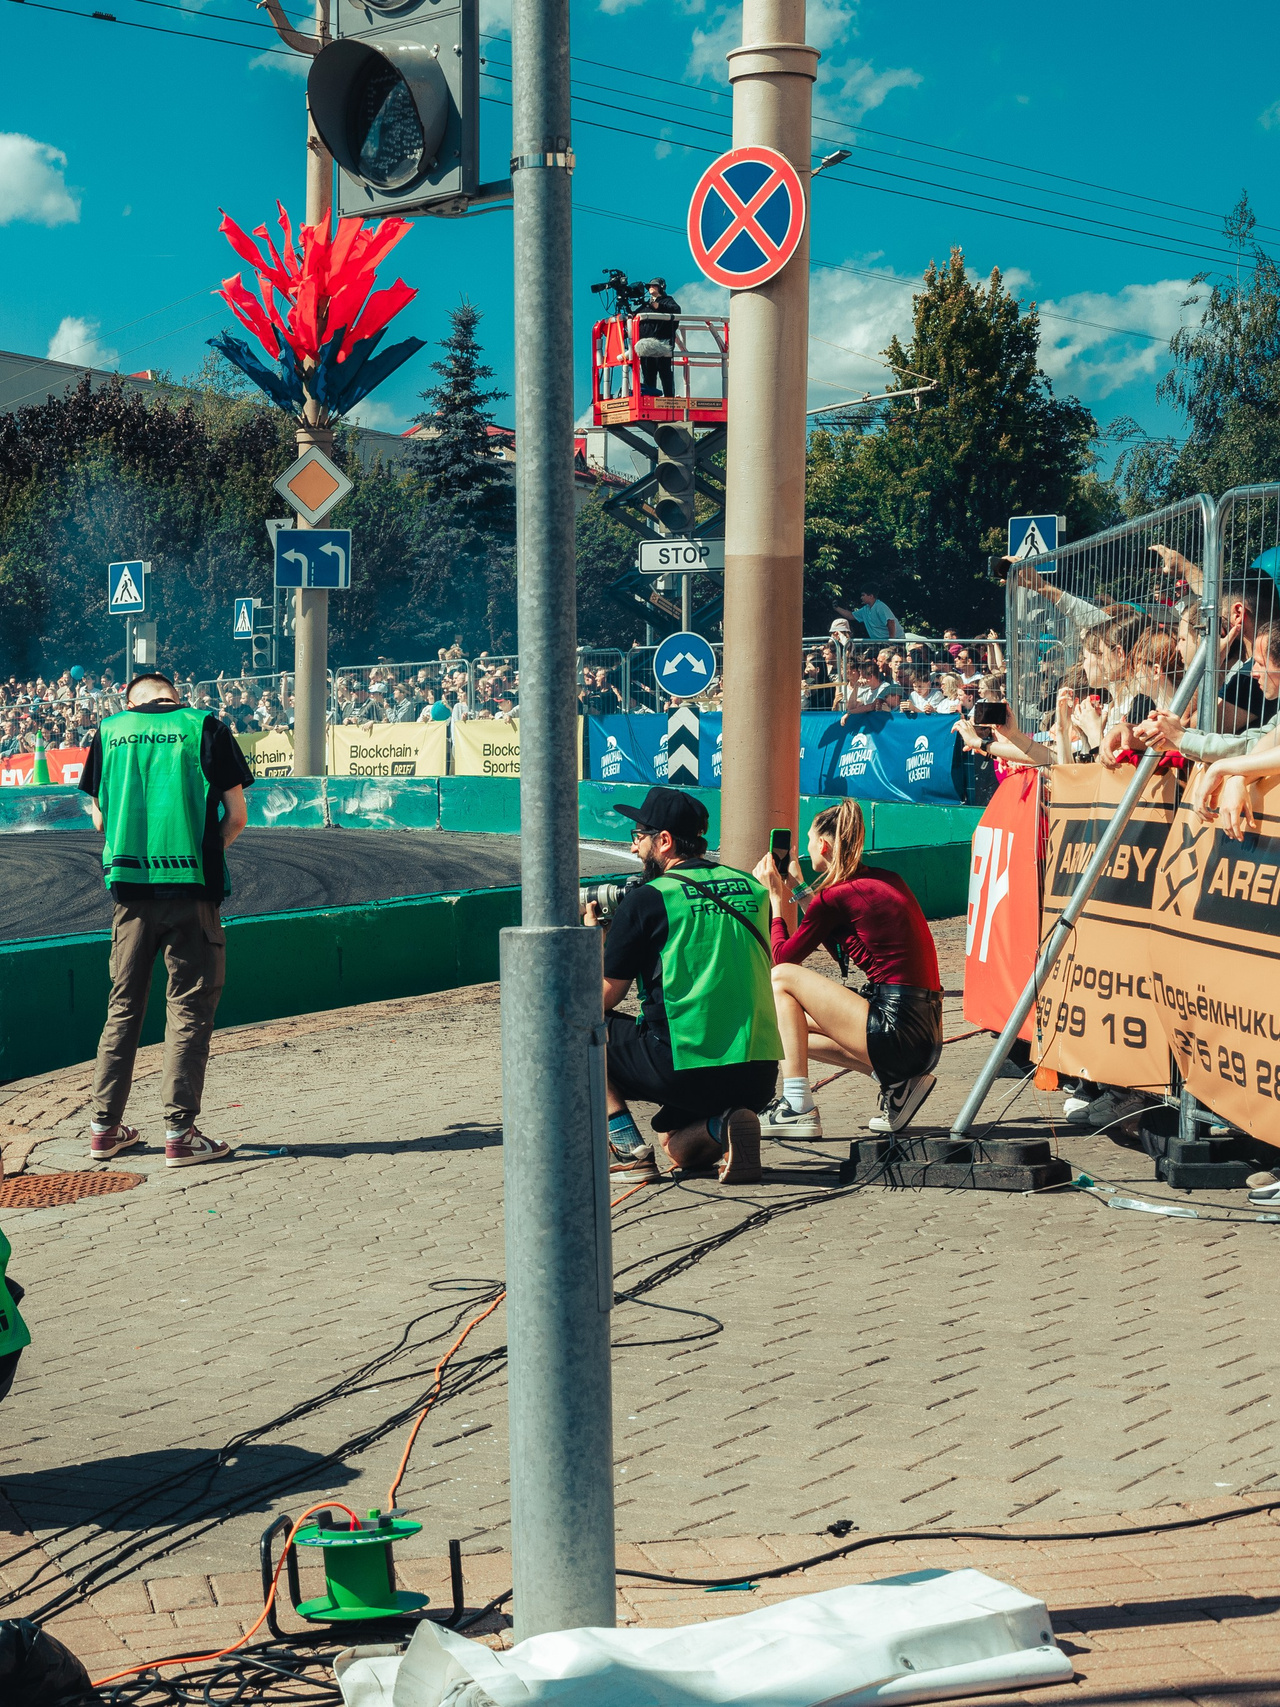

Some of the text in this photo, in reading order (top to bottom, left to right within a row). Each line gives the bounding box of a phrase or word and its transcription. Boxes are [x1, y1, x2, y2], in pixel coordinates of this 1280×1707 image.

[659, 546, 710, 564] STOP
[109, 733, 188, 749] RACINGBY
[244, 750, 286, 764] ckchain
[350, 744, 412, 758] Blockchain
[483, 743, 520, 756] Blockc
[653, 750, 668, 768] ЛИМО
[838, 750, 872, 767] ЛИМОНАД
[905, 752, 934, 772] ЛИМОНАД
[349, 762, 415, 775] Sports DRIFT
[483, 760, 520, 776] Sports
[656, 763, 668, 779] КАЗБ
[840, 763, 867, 778] КАЗБЕГИ
[908, 766, 931, 783] КАЗБЕГИ
[685, 881, 749, 896] BTERA
[966, 825, 1014, 963] BY
[690, 901, 759, 917] PRSS
[1152, 970, 1280, 1042] Подъёмники
[1101, 1013, 1147, 1049] 19
[1218, 1045, 1247, 1087] 29
